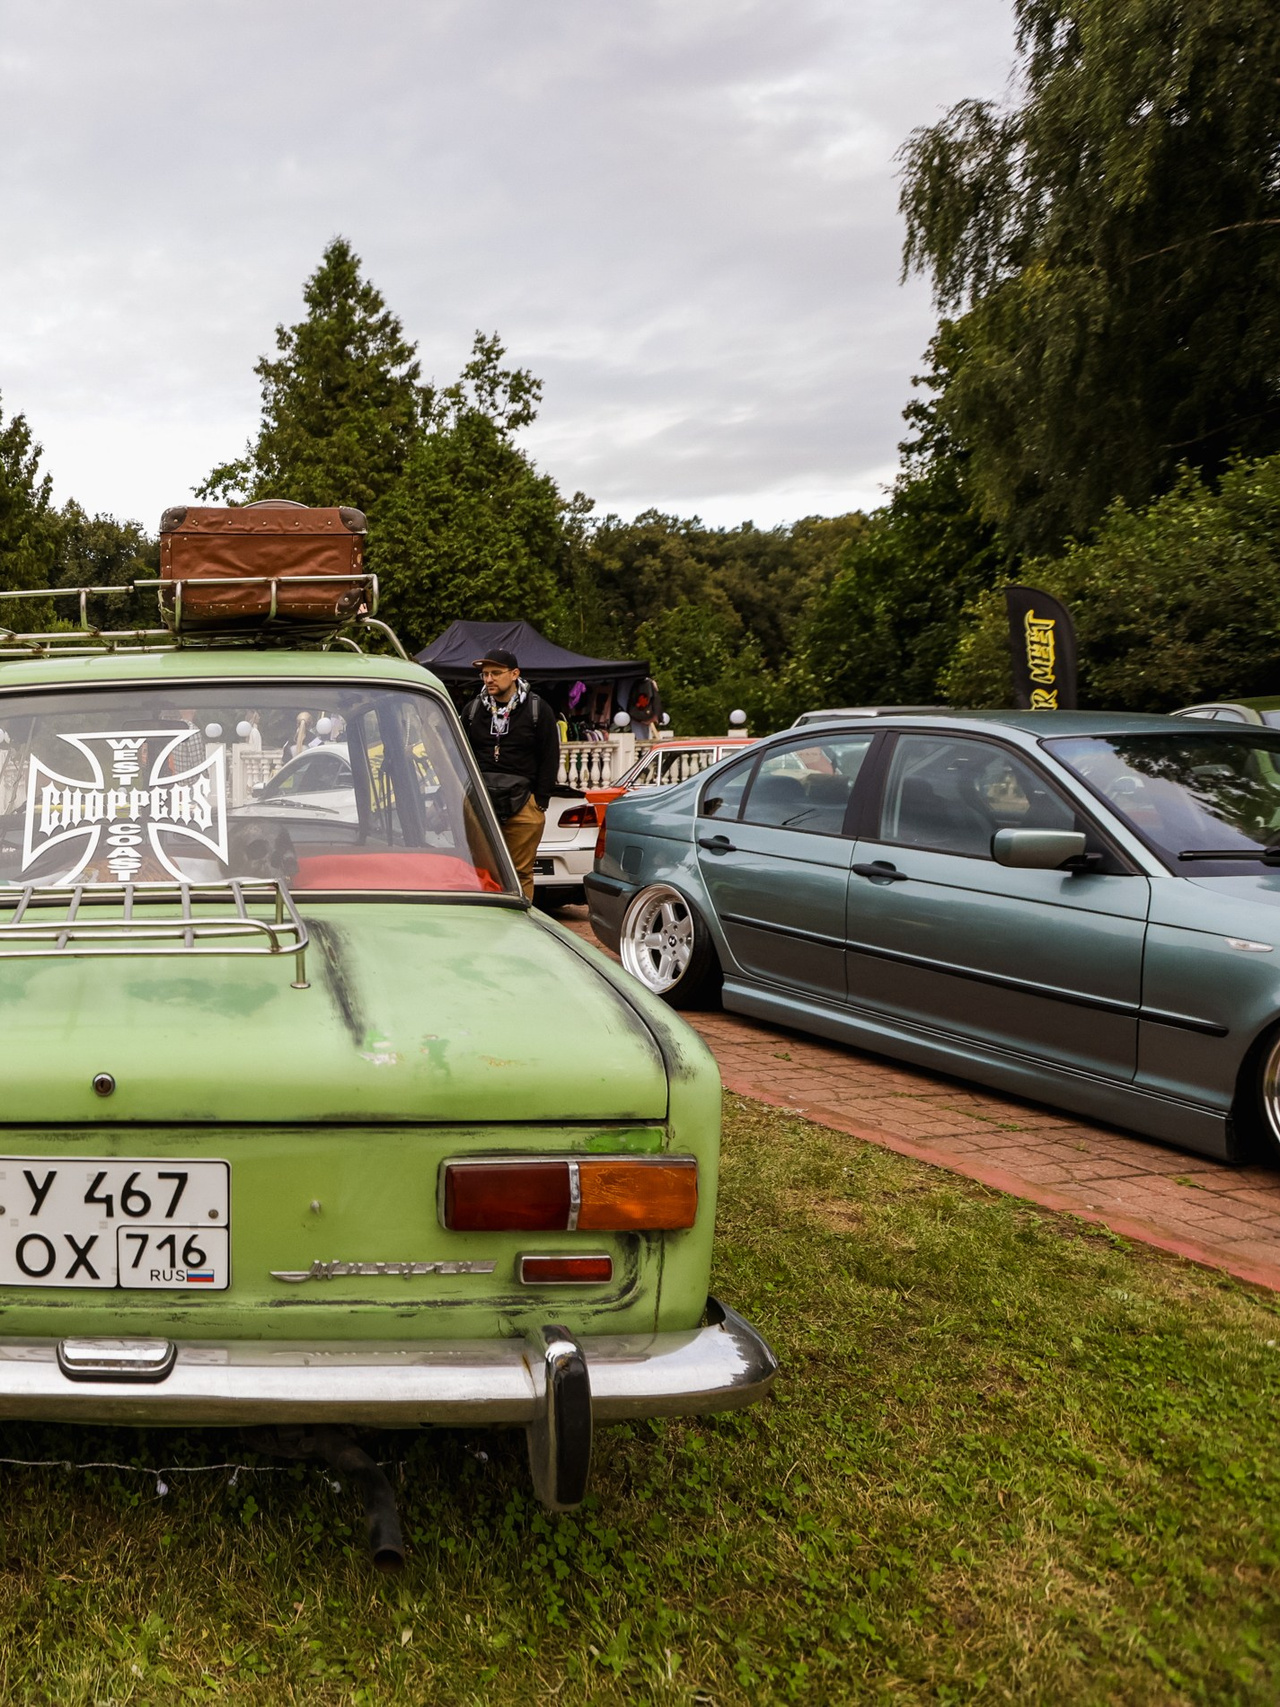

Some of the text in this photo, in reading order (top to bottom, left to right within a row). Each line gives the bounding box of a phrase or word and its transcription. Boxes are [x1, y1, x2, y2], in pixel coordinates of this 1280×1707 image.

[105, 737, 147, 786] WEST
[38, 773, 214, 838] CHOPPERS
[105, 823, 143, 882] COAST
[83, 1171, 189, 1219] 467
[124, 1233, 208, 1269] 716
[149, 1269, 186, 1282] RUS
